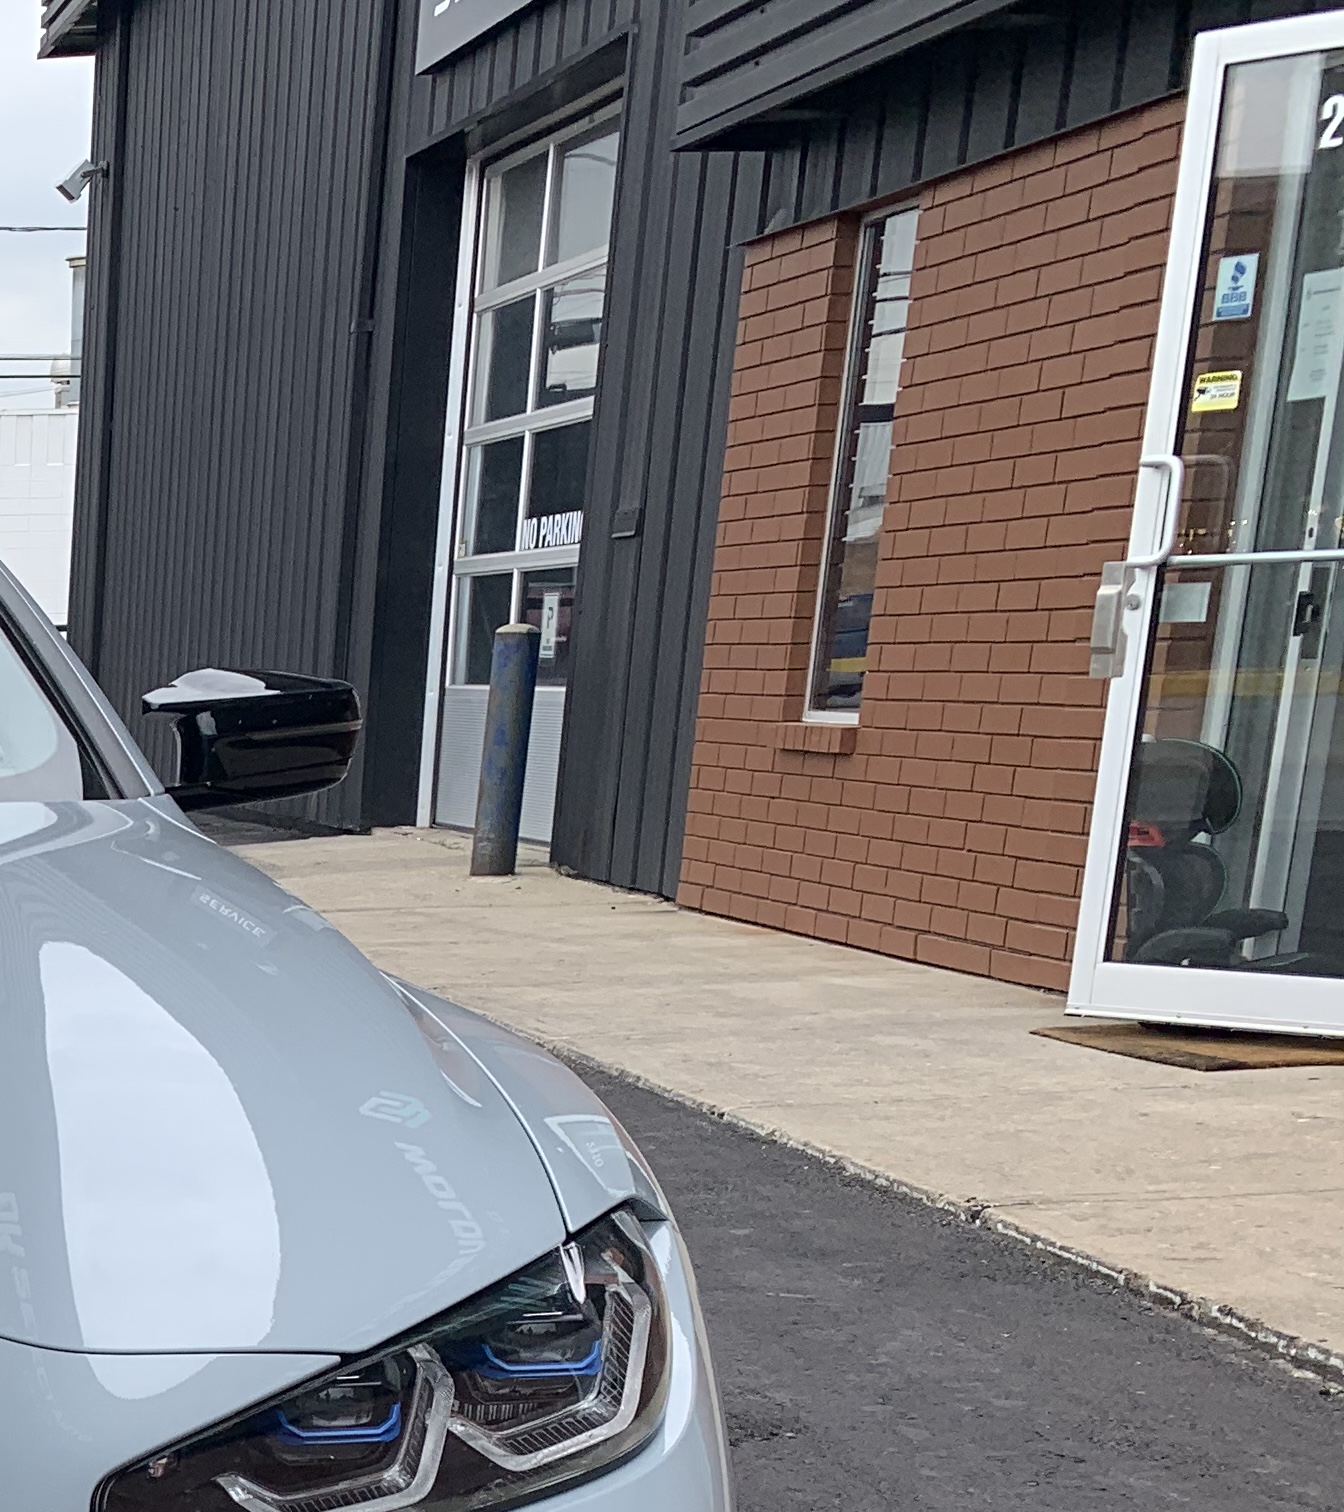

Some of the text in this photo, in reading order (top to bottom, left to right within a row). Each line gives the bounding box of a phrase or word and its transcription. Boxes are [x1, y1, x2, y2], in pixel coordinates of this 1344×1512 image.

[1221, 291, 1247, 304] BBB
[521, 510, 584, 550] NO PARKIN
